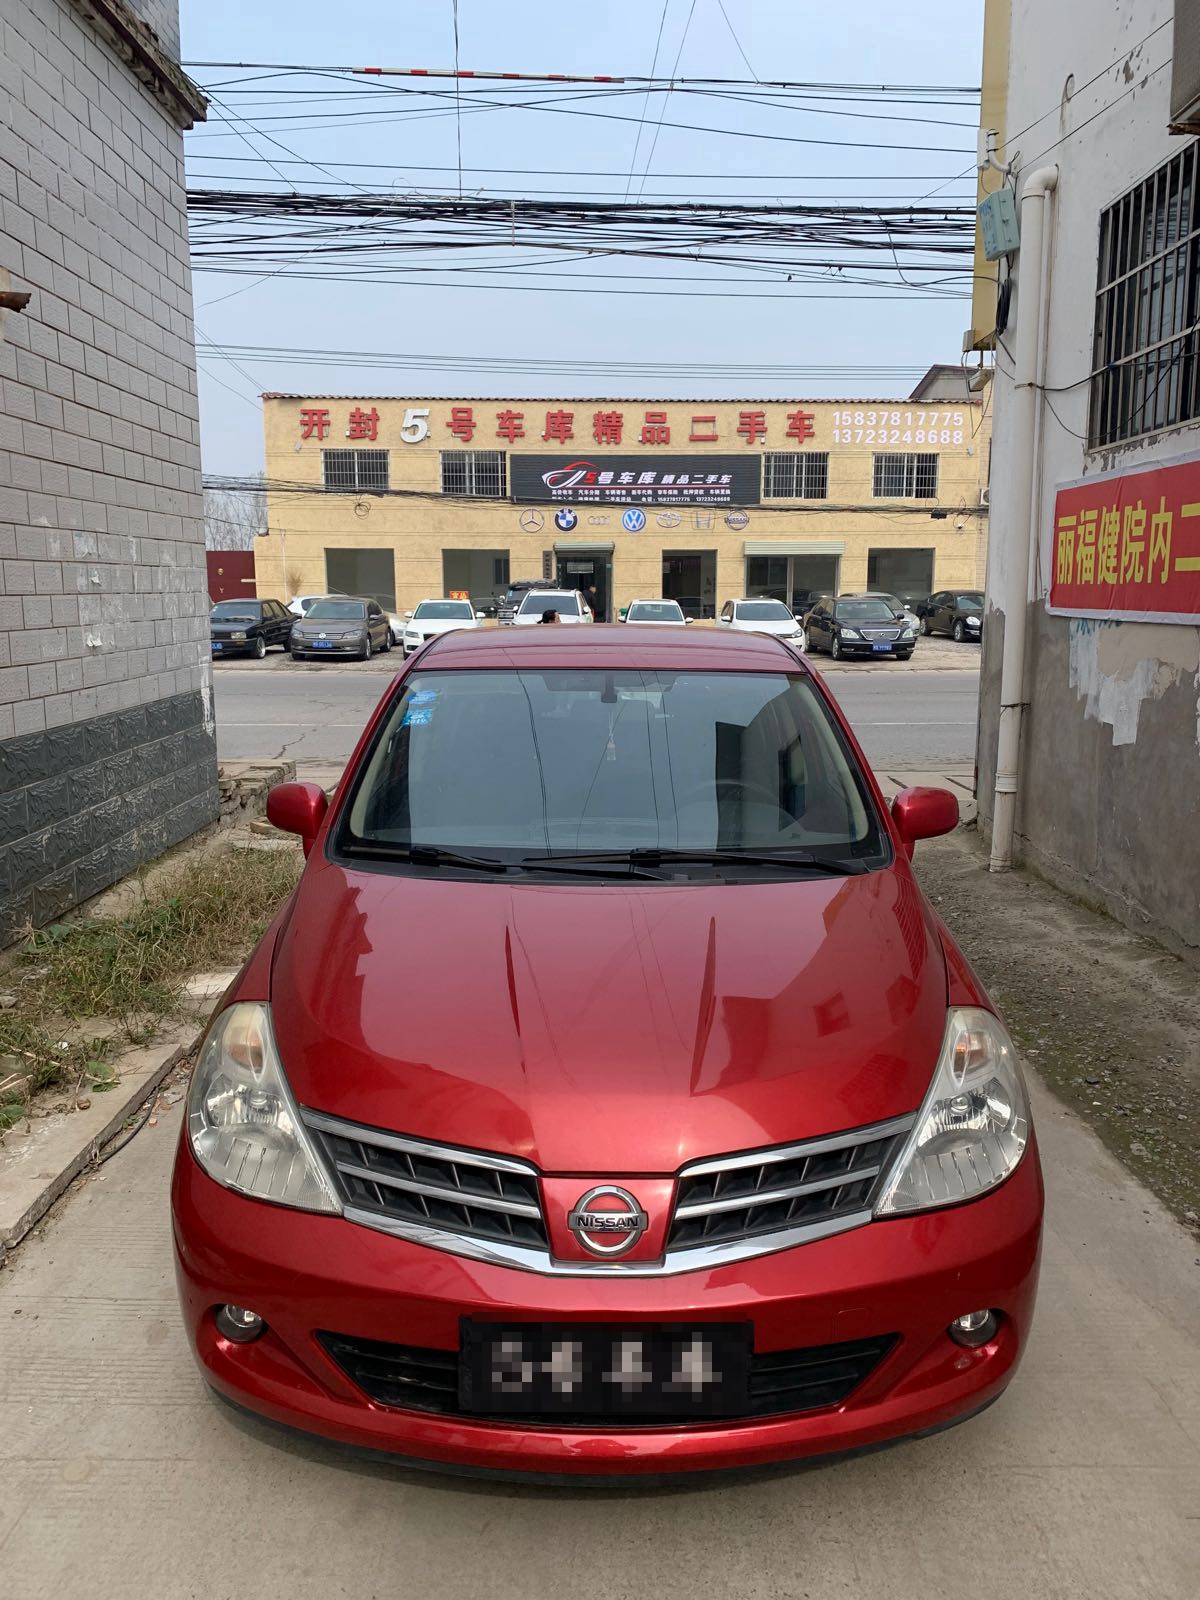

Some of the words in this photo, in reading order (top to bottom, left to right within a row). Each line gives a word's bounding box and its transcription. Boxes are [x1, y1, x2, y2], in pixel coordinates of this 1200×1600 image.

[300, 407, 815, 445] 开封5号车库精品二手车
[832, 411, 964, 427] 15837817775
[832, 428, 964, 445] 13723248688
[577, 1215, 640, 1228] NISSAN
